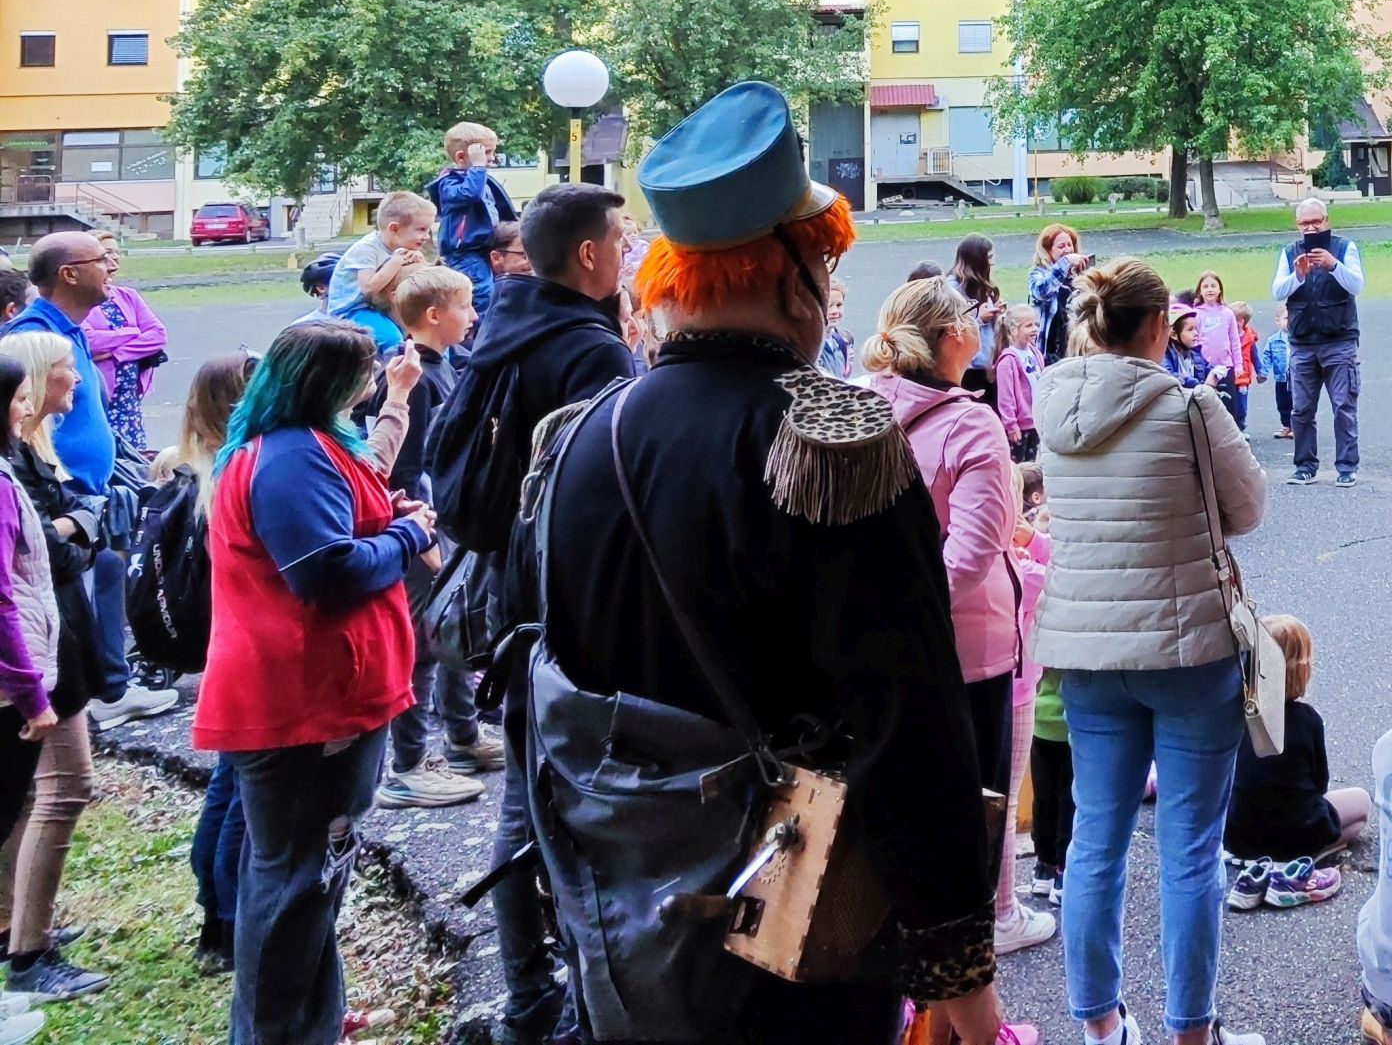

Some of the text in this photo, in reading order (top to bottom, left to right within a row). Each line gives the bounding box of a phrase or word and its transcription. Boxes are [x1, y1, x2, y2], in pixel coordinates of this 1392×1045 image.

[571, 132, 578, 142] 5
[153, 543, 178, 639] UNDER ARMOUR
